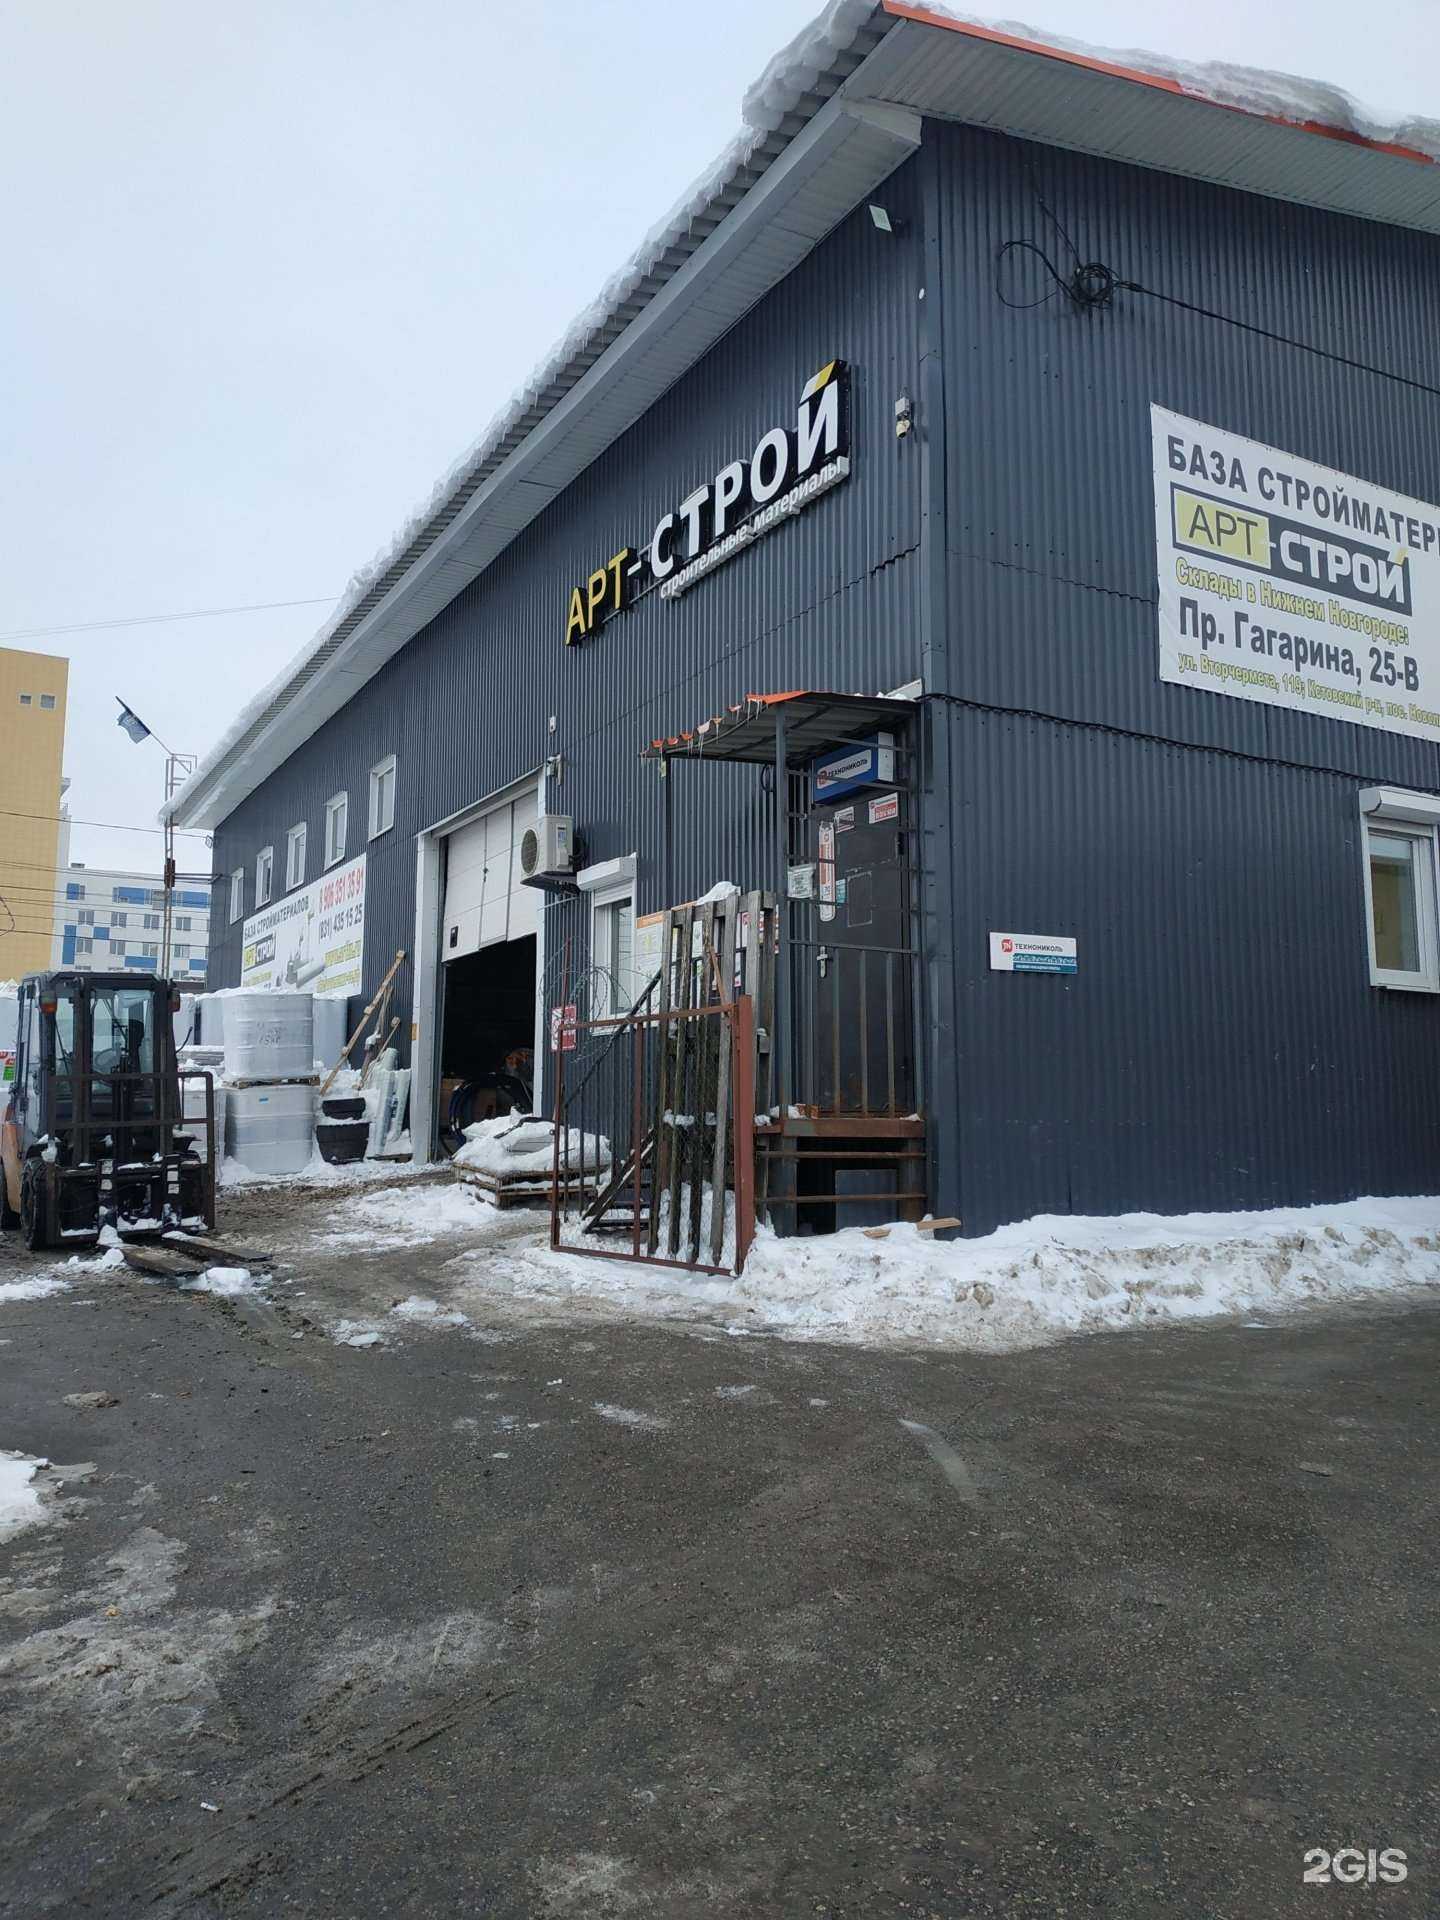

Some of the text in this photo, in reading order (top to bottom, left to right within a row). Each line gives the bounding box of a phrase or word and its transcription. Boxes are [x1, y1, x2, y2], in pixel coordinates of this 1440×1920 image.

[565, 360, 842, 645] АРТ-СТРОЙ
[1167, 434, 1440, 558] БАЗА СТРОЙМАТЕР
[660, 524, 754, 600] строительные
[1176, 556, 1409, 647] Склады в Нижнем Новгороде:
[1178, 652, 1198, 673] ул.
[1200, 654, 1279, 693] Вторчермета,
[1180, 596, 1420, 692] Пр. Гагарина, 25-В
[354, 903, 362, 925] 25
[1014, 943, 1063, 952] ТЕХНОНИКОЛЬ
